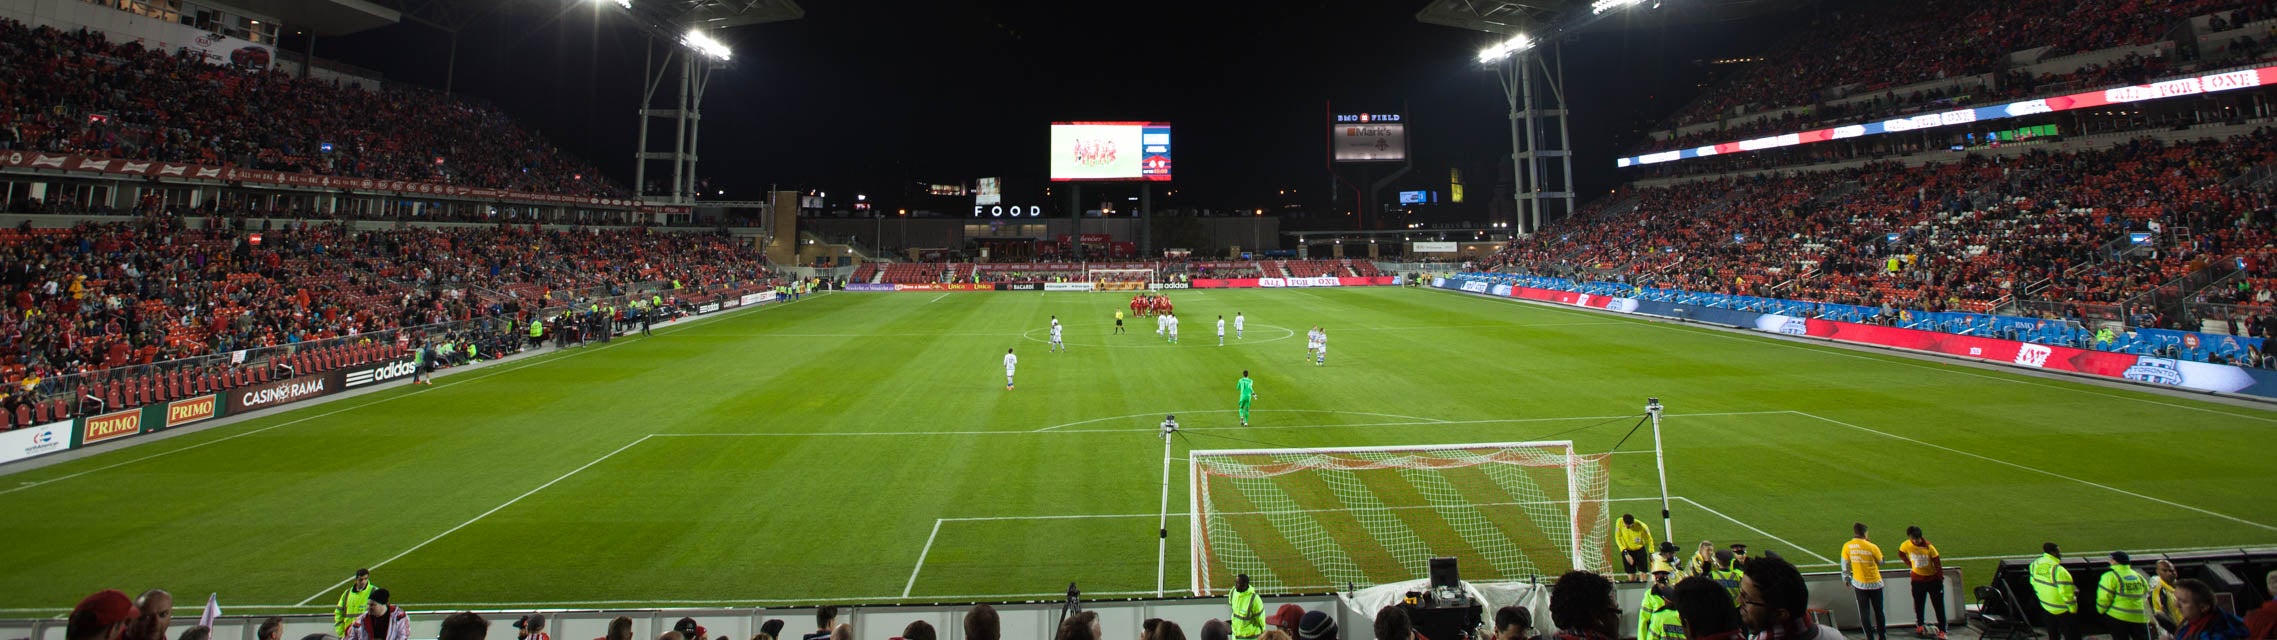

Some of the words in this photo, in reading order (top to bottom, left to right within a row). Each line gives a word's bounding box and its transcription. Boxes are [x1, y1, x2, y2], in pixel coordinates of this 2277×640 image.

[2159, 81, 2193, 97] FOR
[2211, 73, 2251, 88] ONE
[1337, 114, 1358, 122] BMO
[1371, 114, 1401, 122] FIELD
[1356, 127, 1392, 137] Mark's
[974, 205, 1041, 217] FOOD
[1164, 281, 1189, 289] adidas
[374, 360, 416, 382] adidas
[2133, 367, 2176, 378] TORONTO
[170, 400, 213, 421] PRIMO
[88, 415, 138, 438] PRIMO
